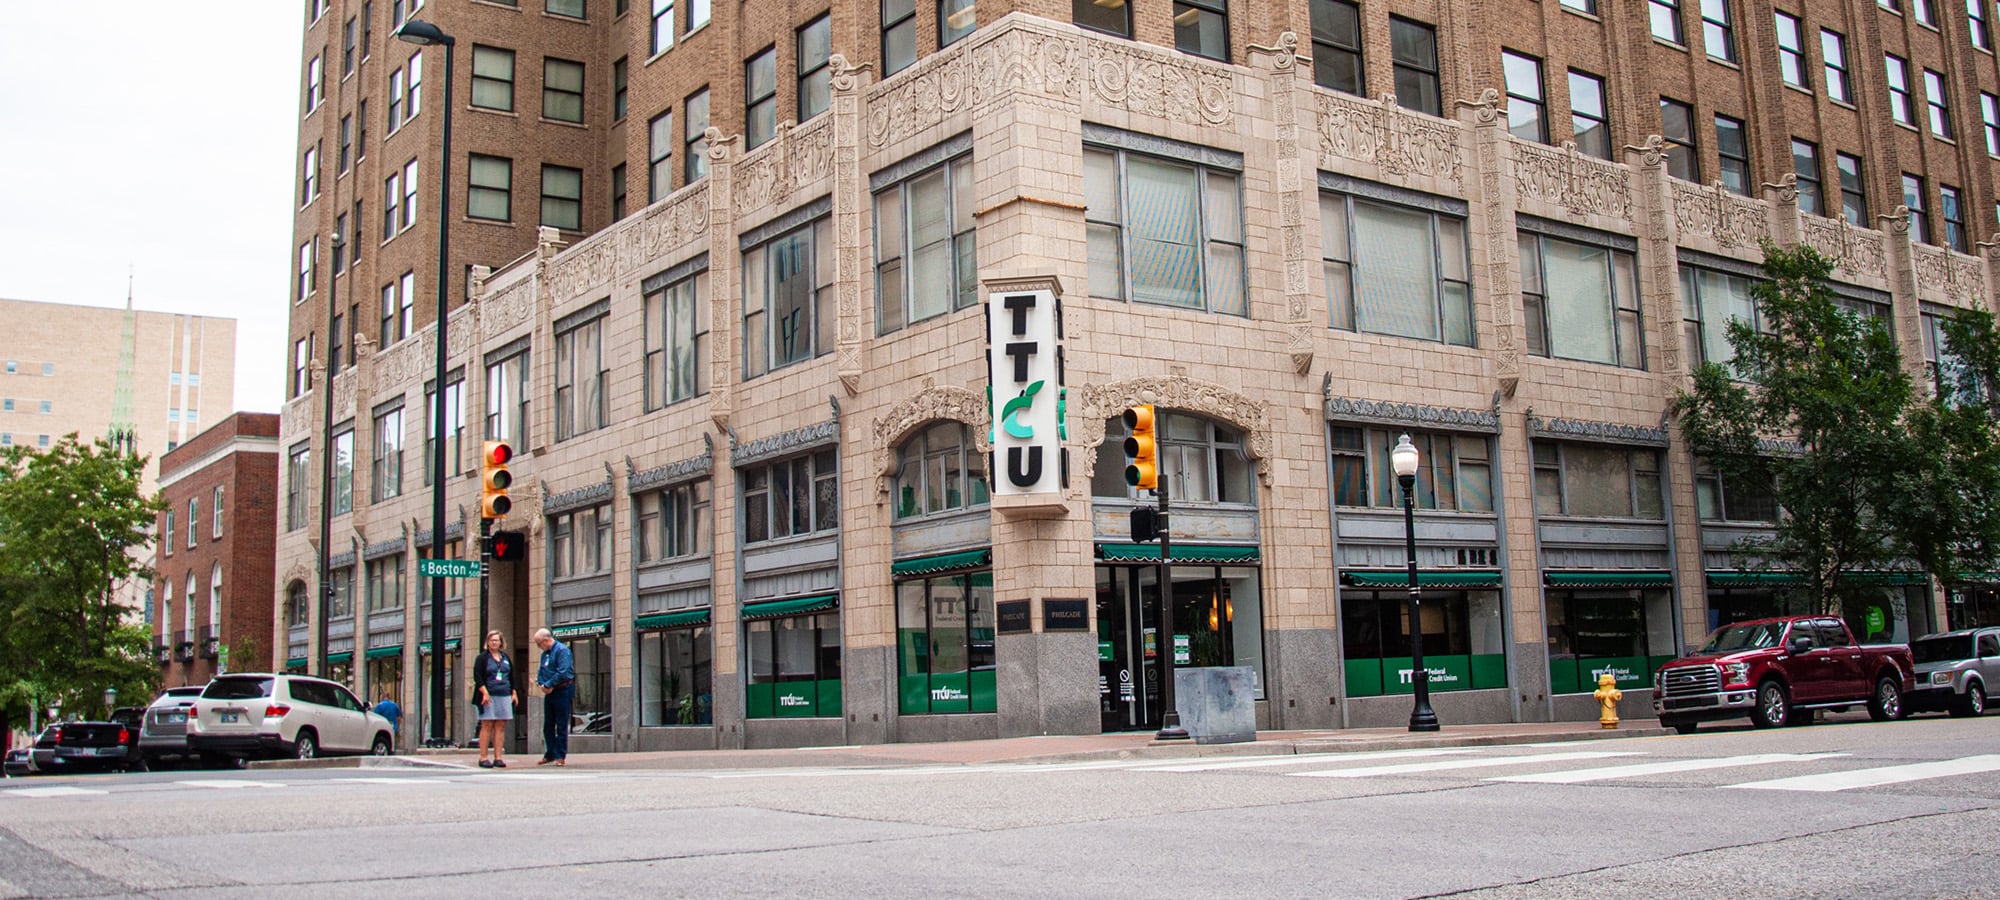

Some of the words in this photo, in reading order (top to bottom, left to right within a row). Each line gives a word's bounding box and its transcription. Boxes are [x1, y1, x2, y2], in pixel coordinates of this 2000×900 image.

[1003, 294, 1045, 488] TTCU
[427, 561, 466, 575] Boston
[578, 625, 605, 635] BUILDING
[1428, 667, 1446, 675] Federal
[1443, 674, 1458, 682] Union
[931, 685, 950, 700] TTCU
[780, 693, 795, 706] TTCU
